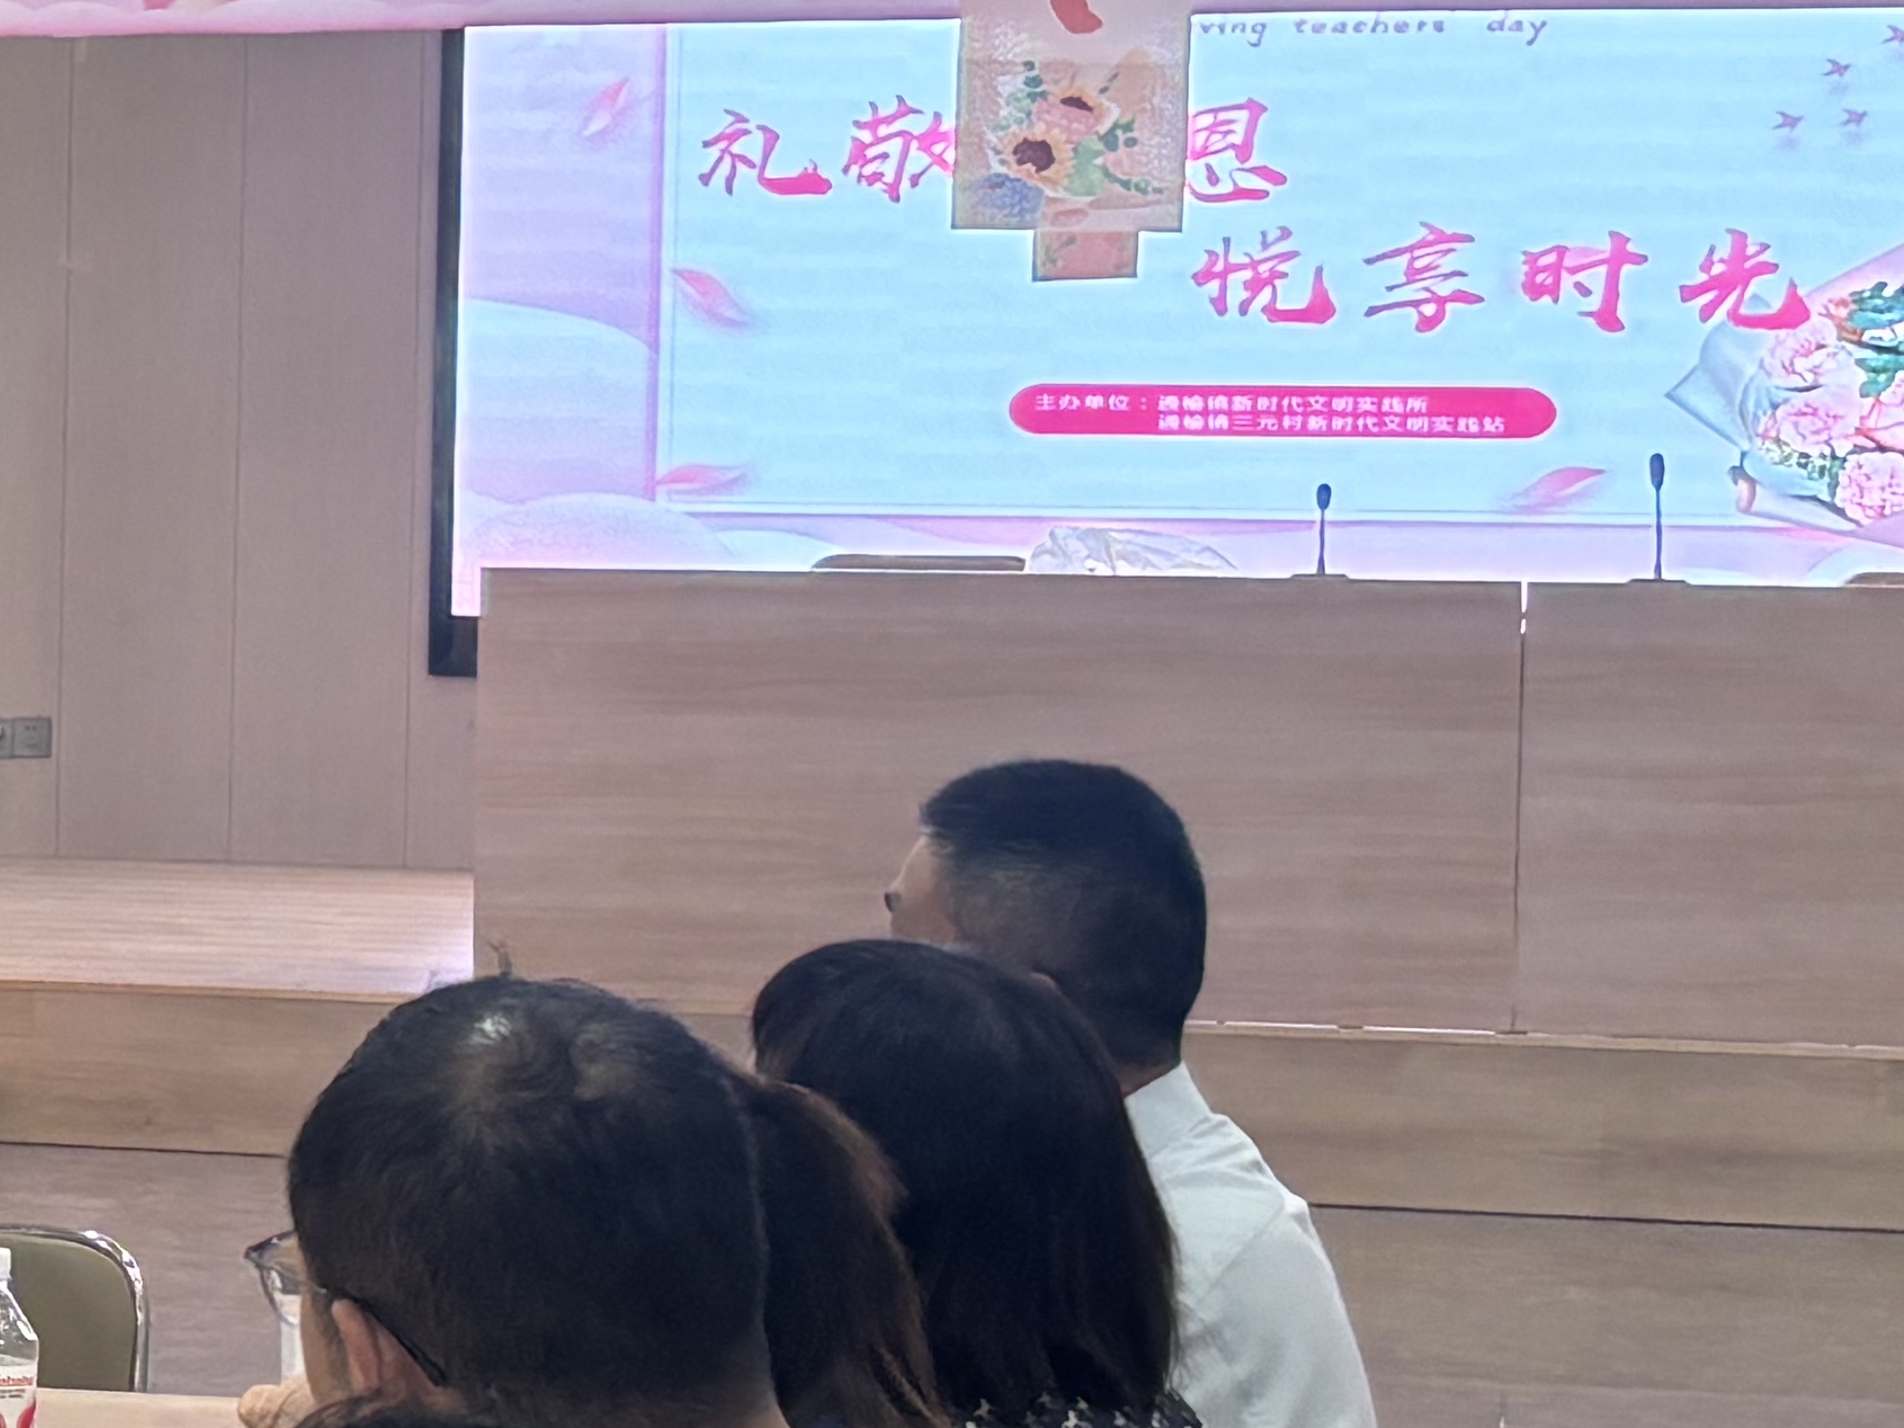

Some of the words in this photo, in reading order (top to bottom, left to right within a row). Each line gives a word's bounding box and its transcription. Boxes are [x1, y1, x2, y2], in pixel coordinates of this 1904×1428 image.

[1199, 18, 1267, 47] ving
[1486, 15, 1548, 46] day
[1192, 221, 1810, 332] 悦享时光
